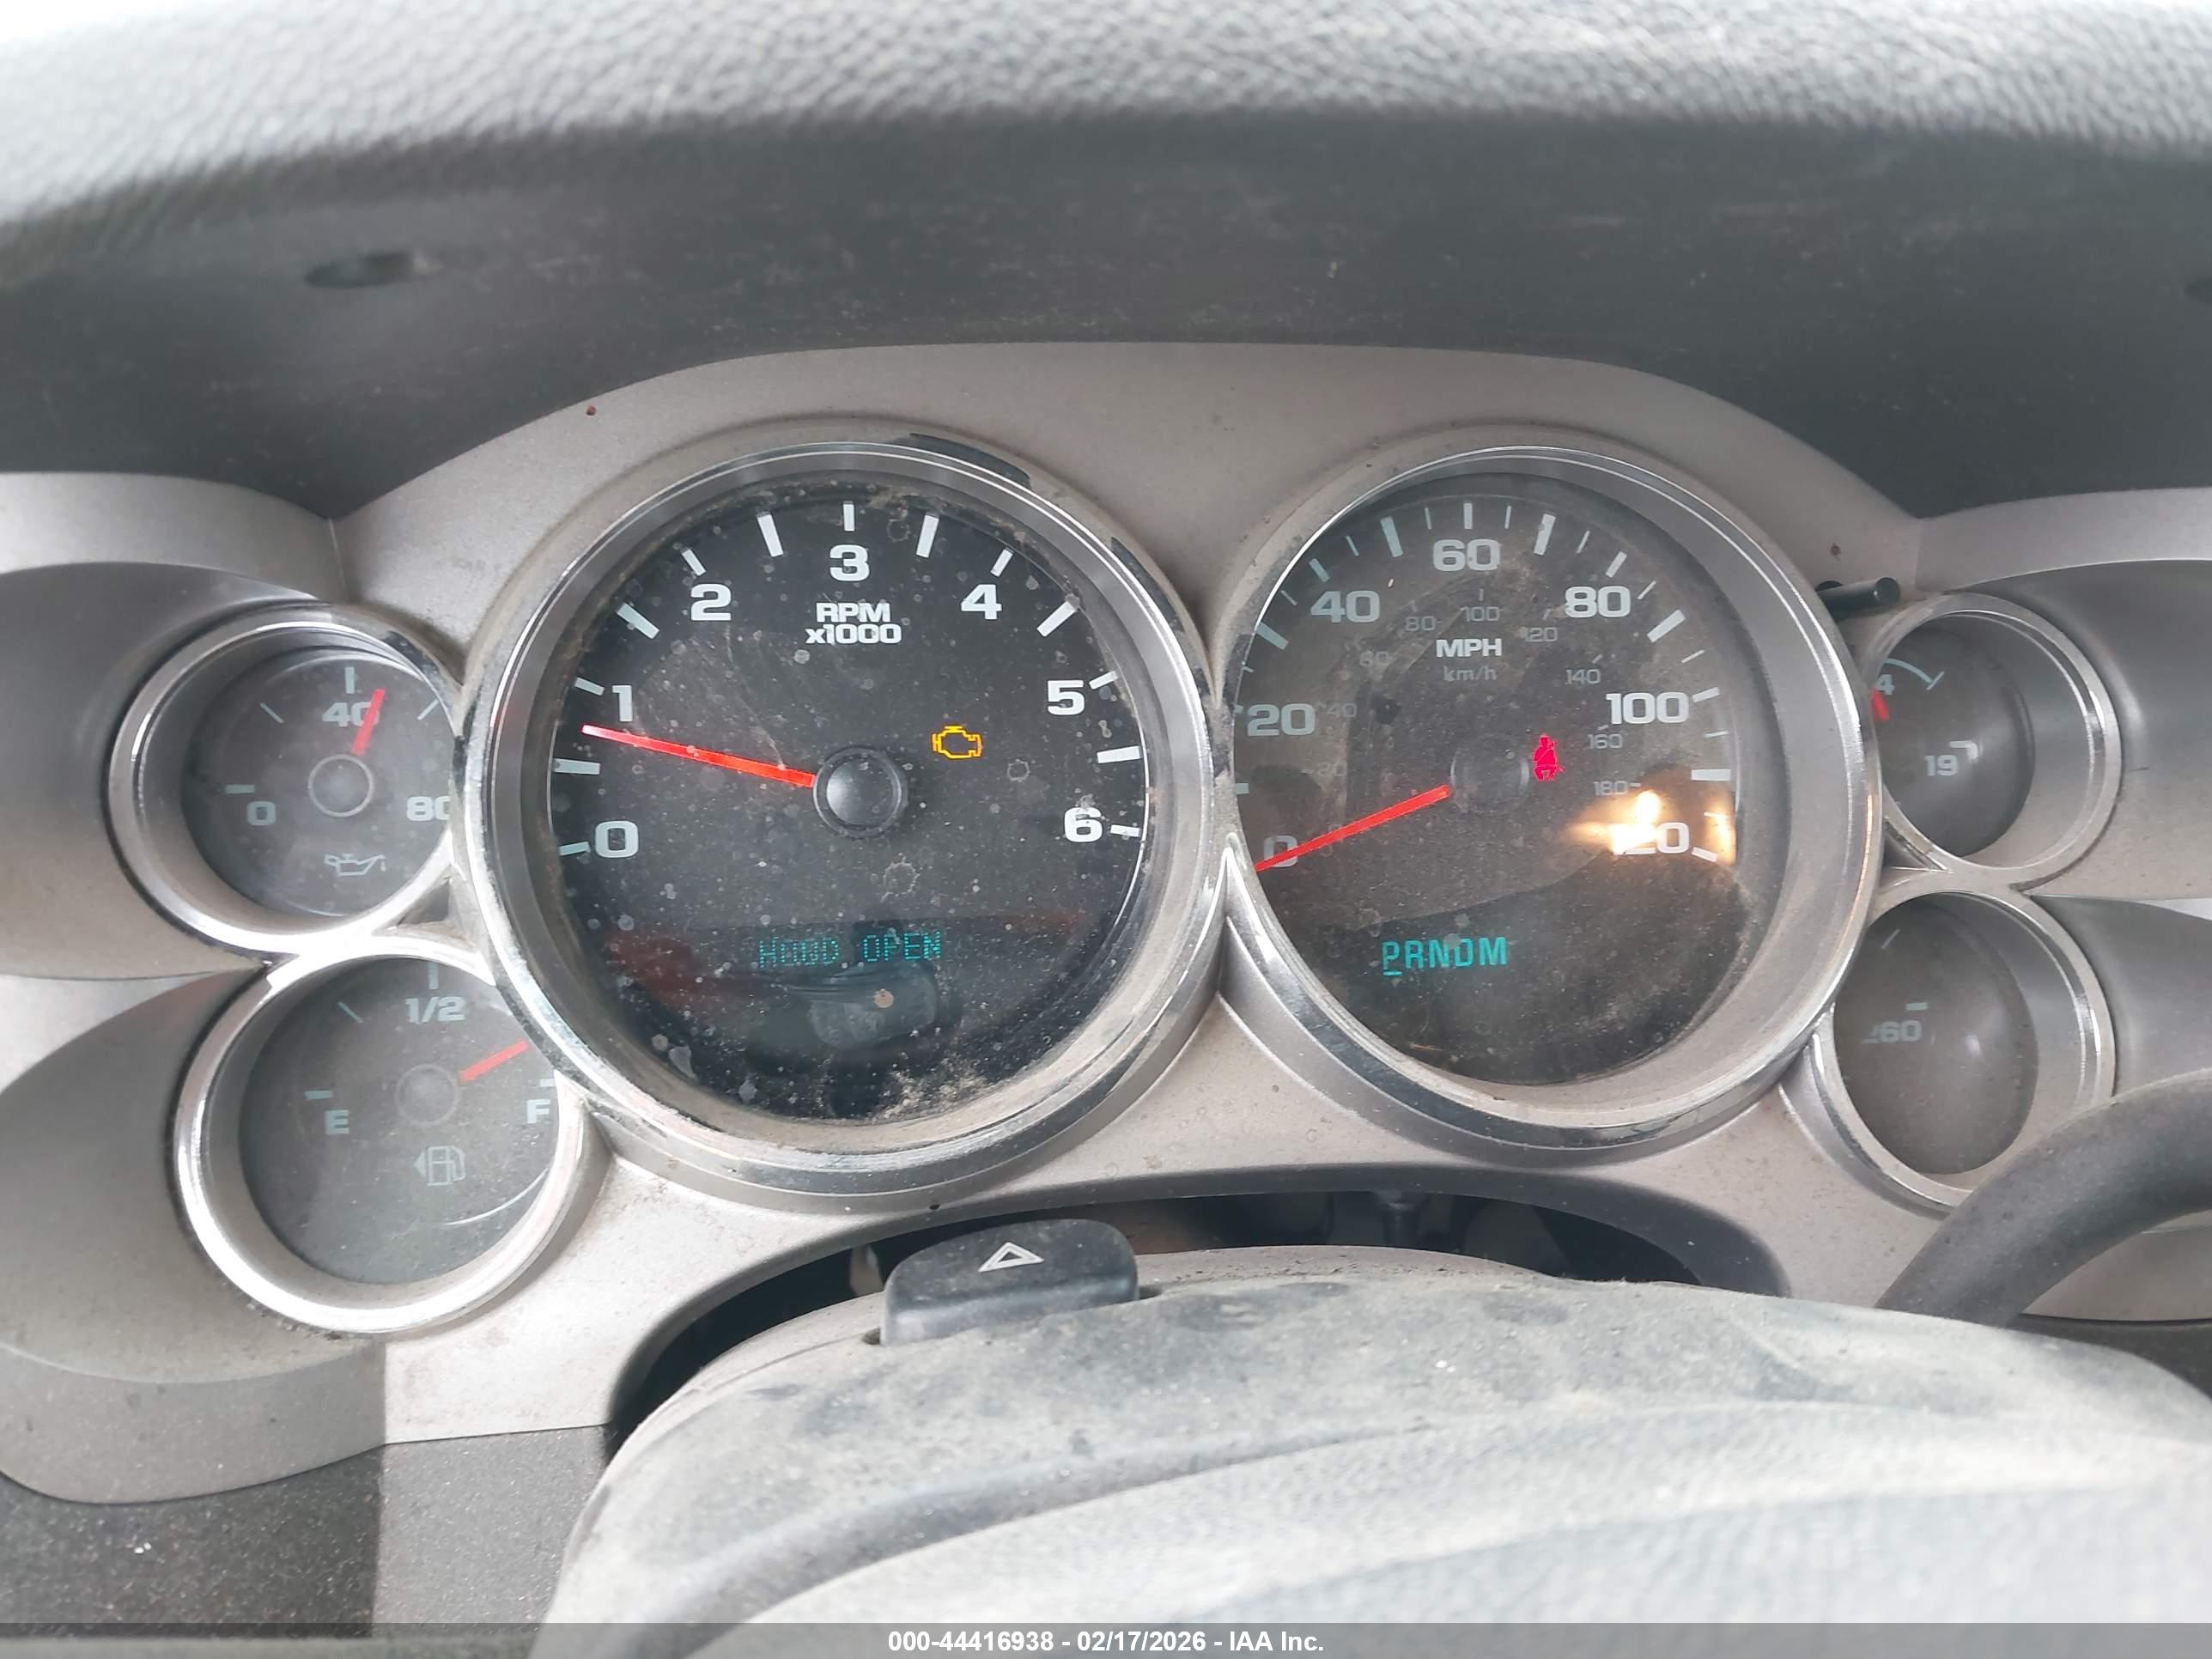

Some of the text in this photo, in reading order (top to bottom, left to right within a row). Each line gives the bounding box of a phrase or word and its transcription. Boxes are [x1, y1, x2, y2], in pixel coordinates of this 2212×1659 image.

[830, 544, 870, 581] 3
[1432, 539, 1501, 571] 60
[690, 584, 732, 621] 2
[816, 602, 891, 623] RPM
[961, 584, 1002, 620] 4
[1310, 590, 1381, 623] 40
[1462, 606, 1500, 622] 100
[1565, 586, 1631, 617] 80
[805, 623, 902, 644] x1000
[1405, 615, 1437, 632] 80
[1525, 627, 1559, 642] 120
[1436, 638, 1503, 658] MPH
[1443, 665, 1498, 682] km/h
[1565, 668, 1601, 685] 140
[612, 684, 634, 722] 1
[1047, 679, 1085, 716] 5
[1606, 692, 1690, 725] 100
[321, 701, 380, 727] 40
[1247, 703, 1316, 737] 20
[1588, 733, 1624, 750] 160
[1924, 754, 1959, 776] 19
[1594, 780, 1629, 796] 180
[247, 801, 276, 826] 0
[1064, 807, 1103, 842] 6
[595, 821, 639, 859] 0
[1263, 835, 1298, 867] 0
[758, 930, 943, 969] HOOD OPEN
[1382, 937, 1509, 974] PRNDM
[406, 996, 466, 1024] 1/2
[325, 1109, 350, 1135] E
[526, 1098, 551, 1124] F
